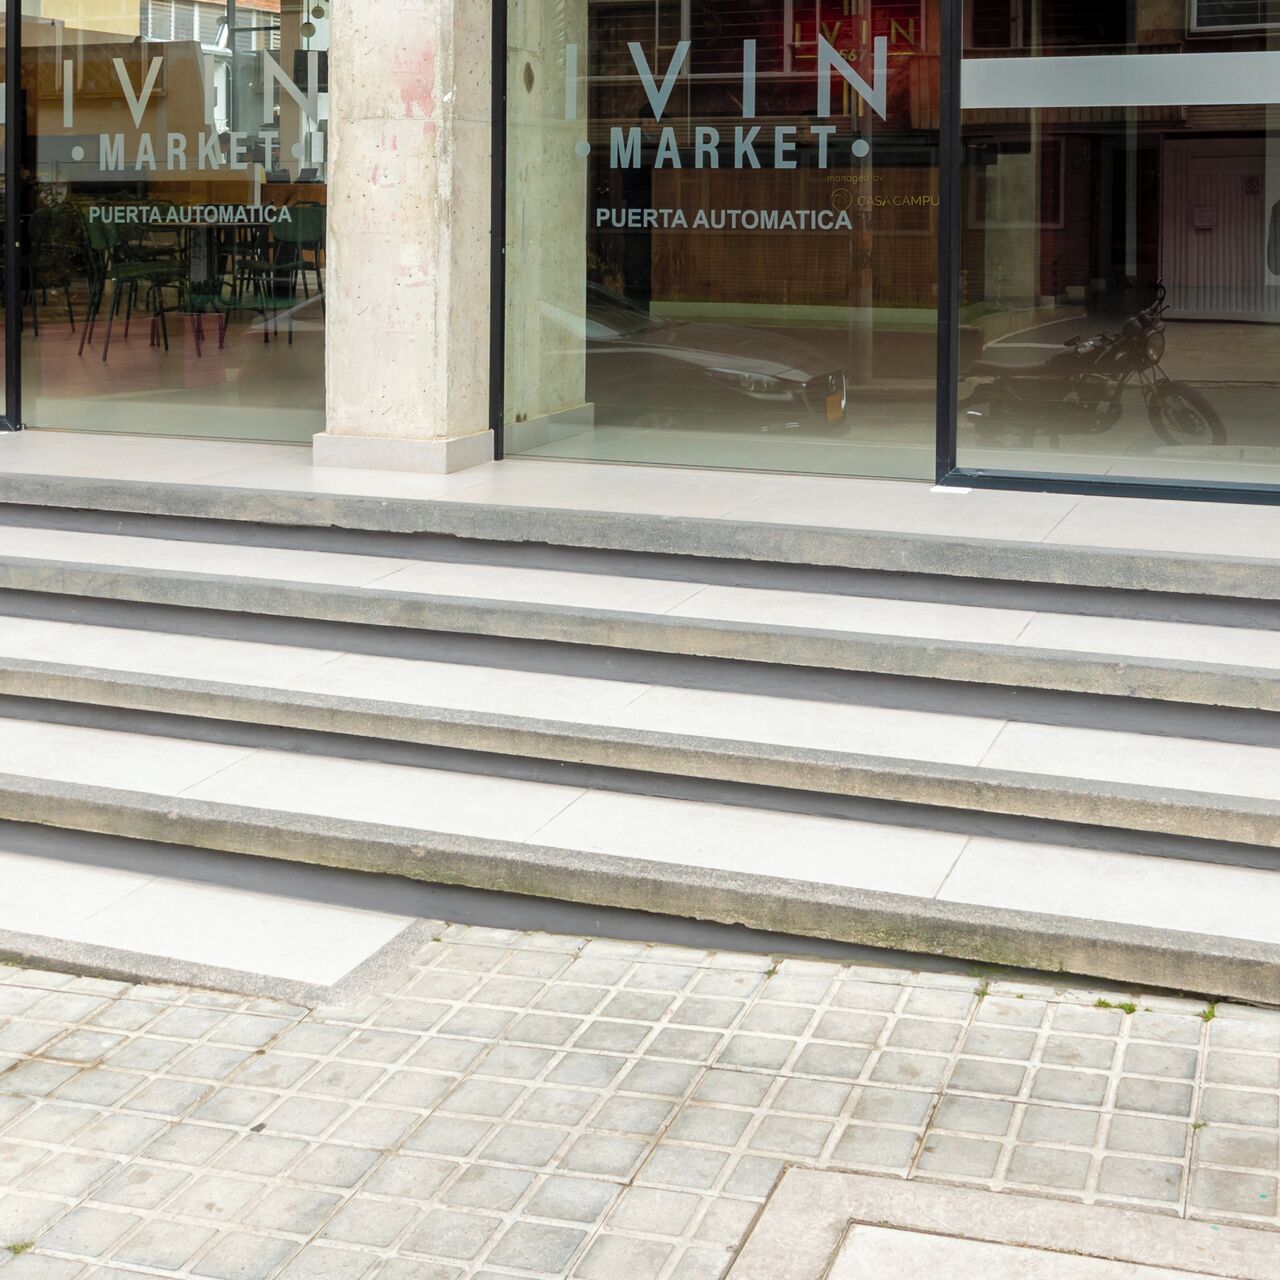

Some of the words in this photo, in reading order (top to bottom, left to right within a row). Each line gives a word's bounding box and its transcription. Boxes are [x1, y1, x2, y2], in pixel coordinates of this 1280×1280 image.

[63, 50, 319, 132] IVIN
[565, 33, 888, 122] IVIN
[99, 131, 279, 171] MARKET
[610, 125, 837, 169] MARKET
[89, 206, 162, 223] PUERTA
[166, 204, 293, 223] AUTOMATICA
[595, 208, 688, 229] PUERTA
[692, 209, 853, 230] AUTOMATICA
[892, 195, 940, 207] CAMPU
